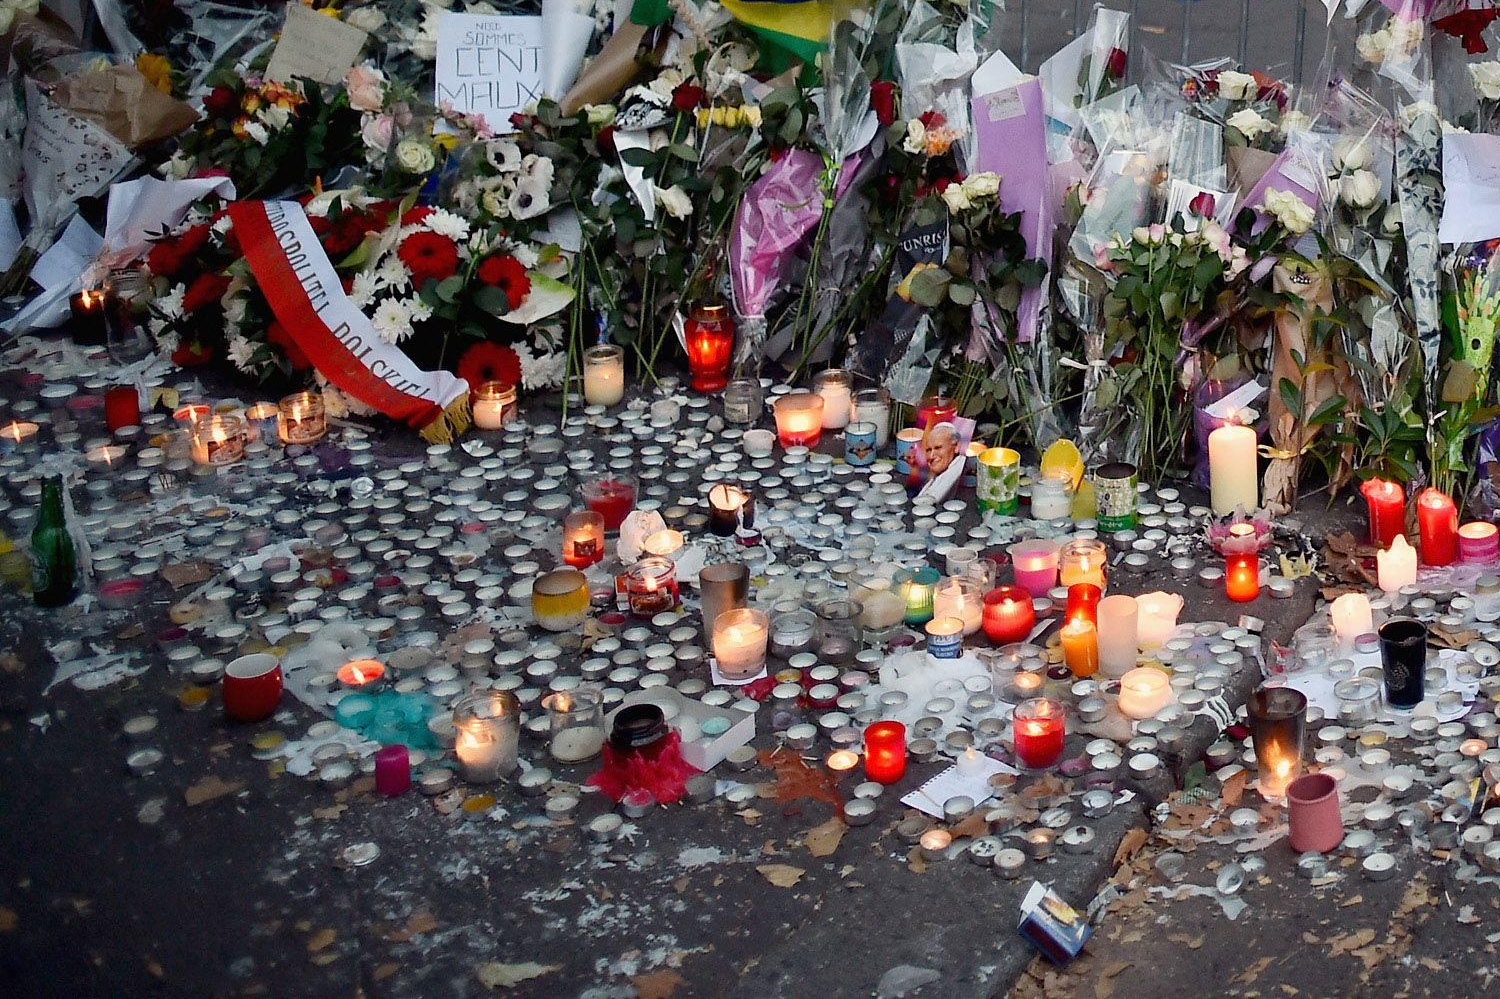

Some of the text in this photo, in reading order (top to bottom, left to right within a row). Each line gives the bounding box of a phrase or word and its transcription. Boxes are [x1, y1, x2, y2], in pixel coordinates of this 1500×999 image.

[465, 31, 527, 46] SOMMES
[456, 46, 542, 77] CENT
[438, 80, 542, 110] MAUX
